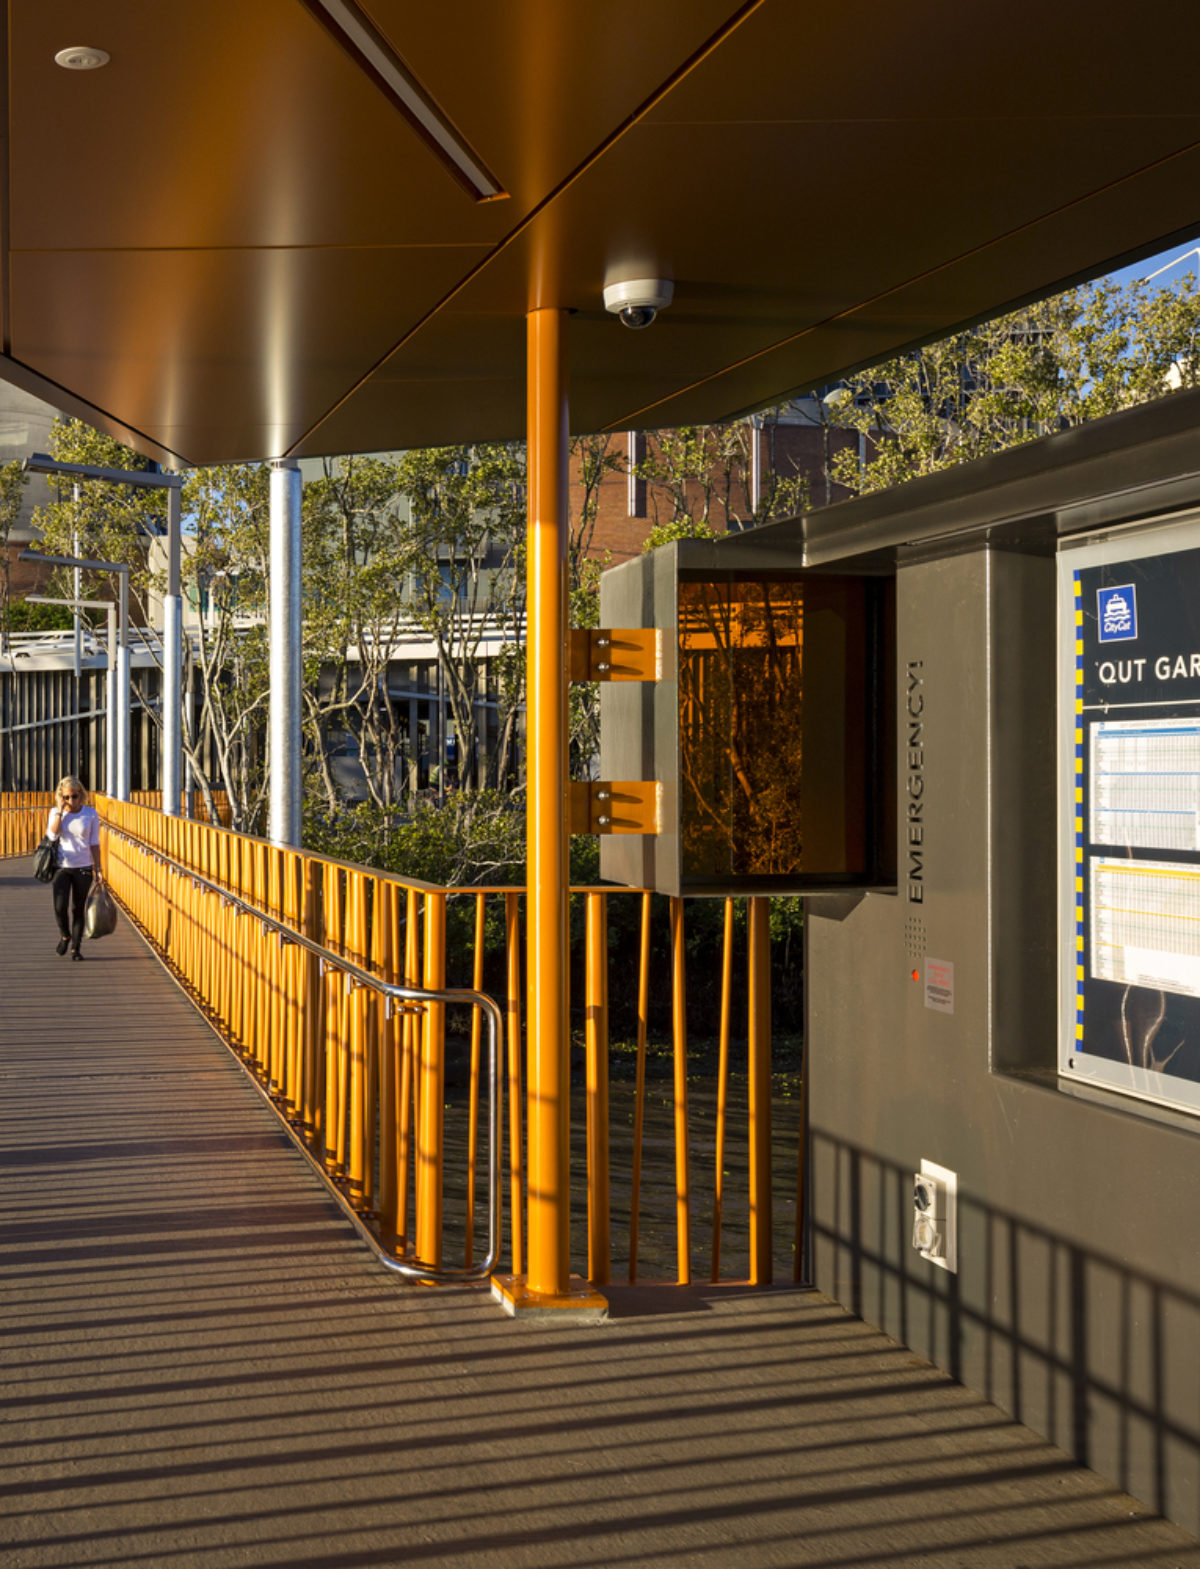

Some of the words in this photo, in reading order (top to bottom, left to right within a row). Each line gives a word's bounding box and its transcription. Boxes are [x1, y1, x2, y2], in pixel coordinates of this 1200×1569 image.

[1099, 659, 1147, 683] QUT
[1155, 654, 1200, 680] GAR
[907, 660, 924, 904] EMERGENCY!
